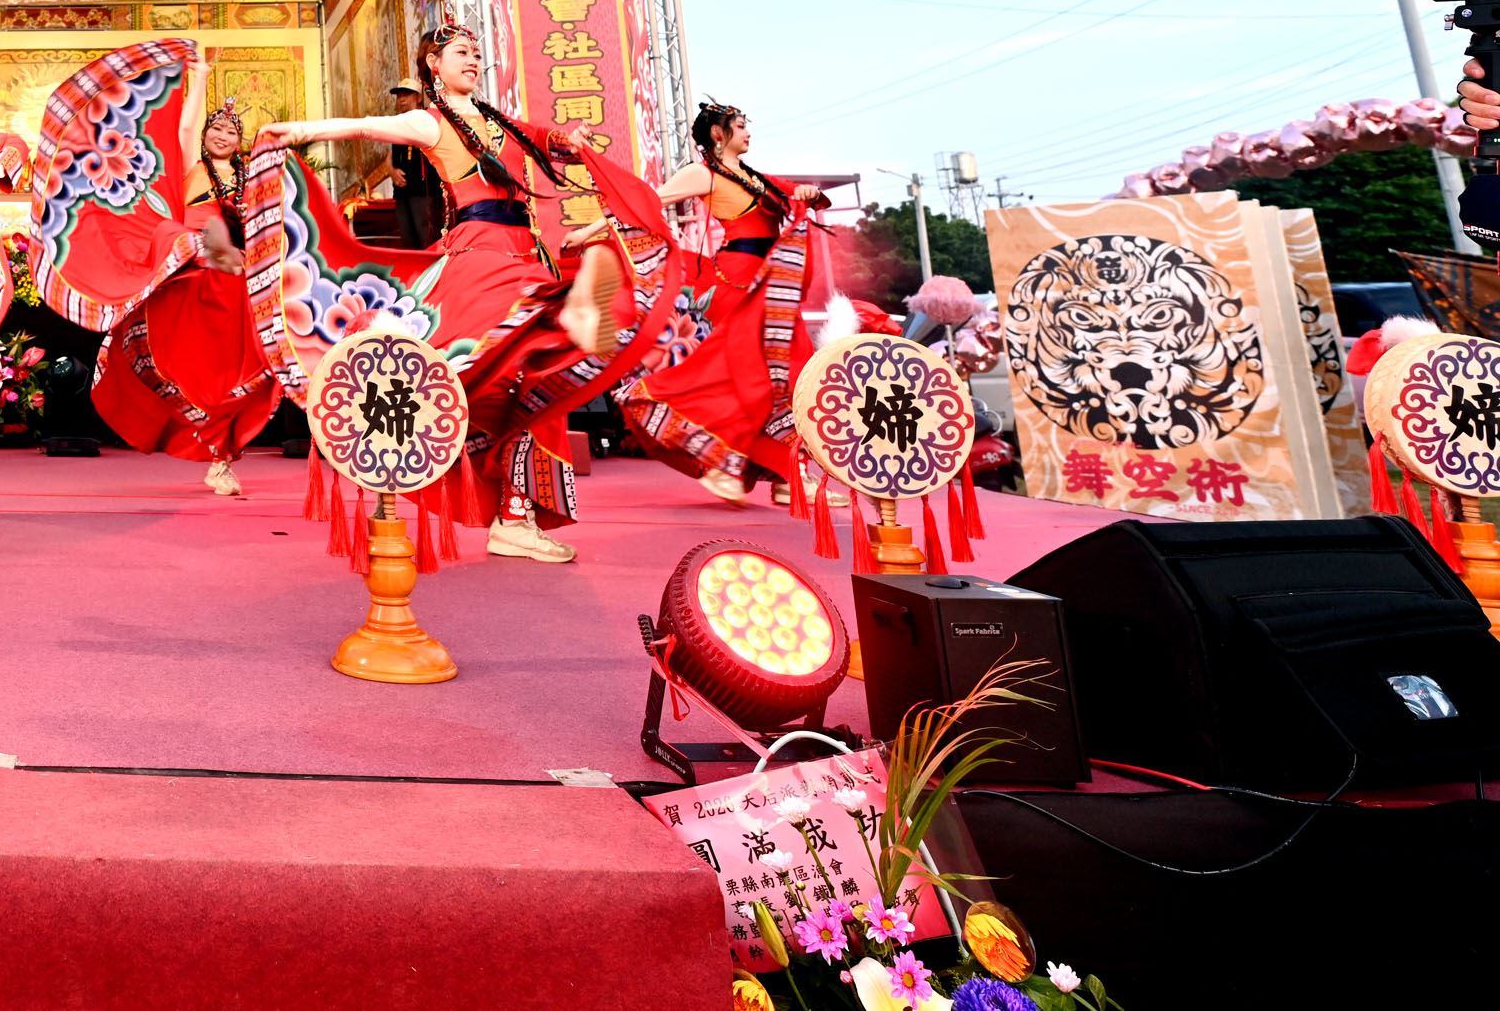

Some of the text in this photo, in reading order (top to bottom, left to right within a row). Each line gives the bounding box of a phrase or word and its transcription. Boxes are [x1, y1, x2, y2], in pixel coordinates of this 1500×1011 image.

[1062, 449, 1250, 507] 舞空術
[955, 627, 975, 636] Spark
